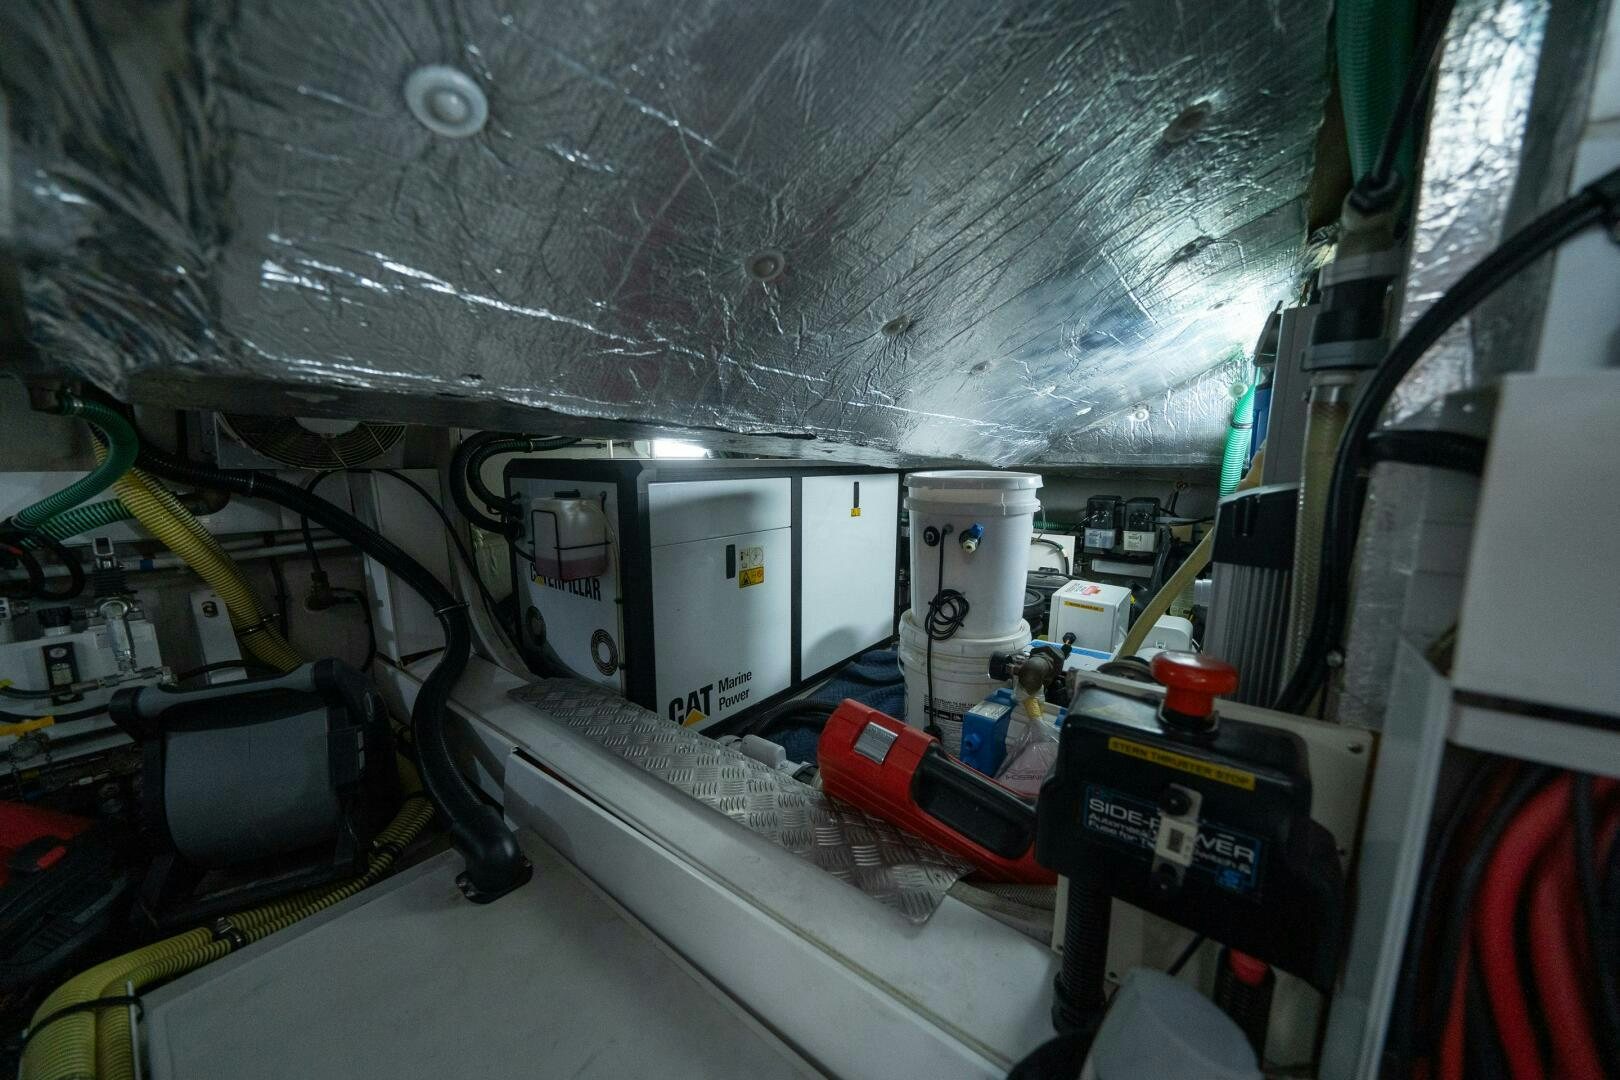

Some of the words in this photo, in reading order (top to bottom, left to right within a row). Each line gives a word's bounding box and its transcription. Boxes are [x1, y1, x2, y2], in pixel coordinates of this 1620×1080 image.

[718, 671, 752, 694] Marine
[719, 688, 750, 711] Power
[668, 684, 714, 726] CAT
[1112, 740, 1148, 757] STERN
[1216, 769, 1252, 786] STOP
[1089, 797, 1255, 865] SIDE-PWER
